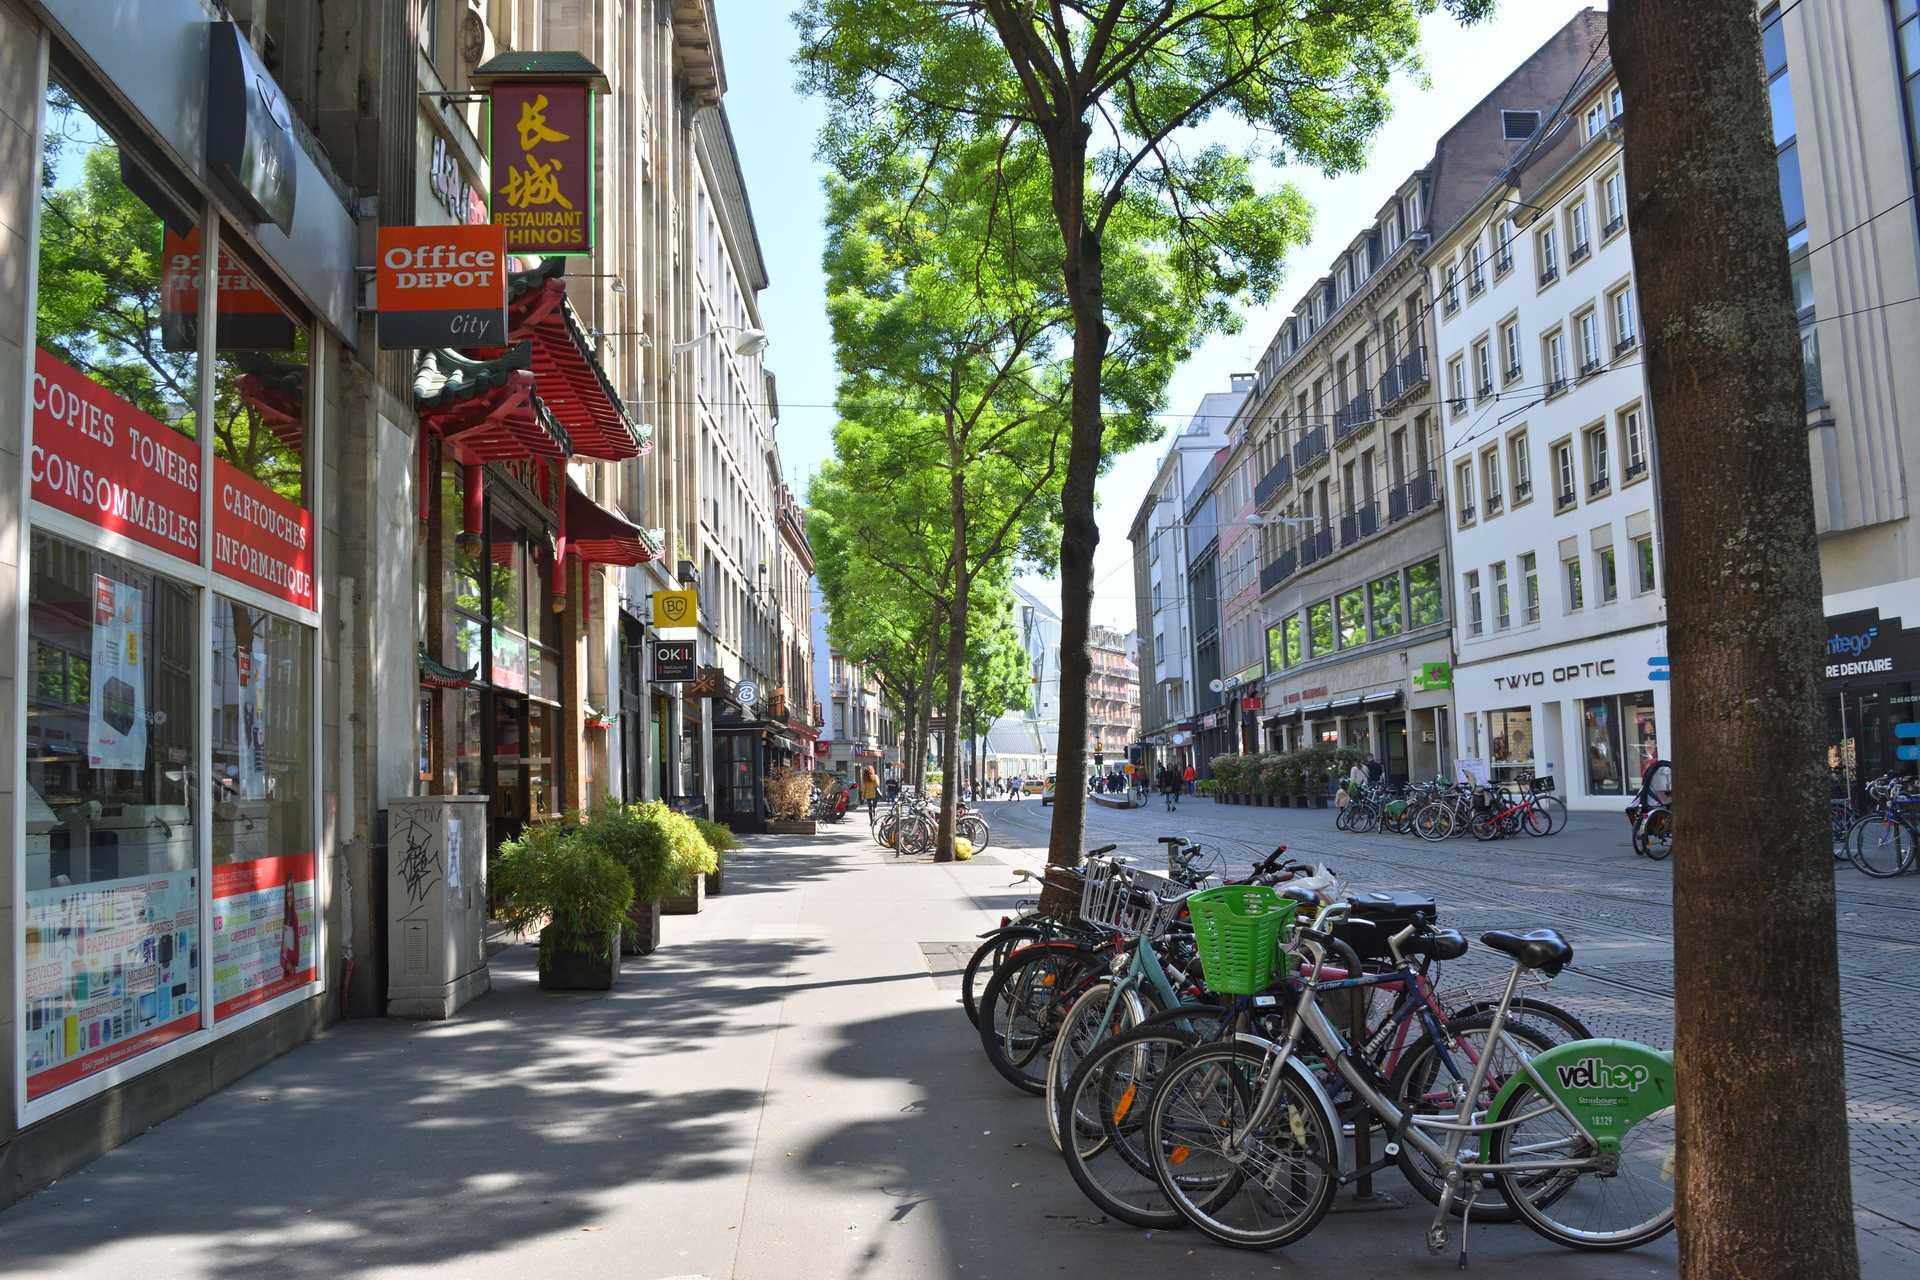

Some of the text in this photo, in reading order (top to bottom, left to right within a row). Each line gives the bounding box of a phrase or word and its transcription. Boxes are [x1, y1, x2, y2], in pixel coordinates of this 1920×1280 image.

[499, 93, 573, 210] 长城
[494, 211, 583, 227] RESTAURANT
[508, 228, 583, 245] HINOIS
[384, 244, 496, 270] Office
[395, 270, 494, 289] DEPOT
[450, 314, 491, 340] City
[32, 373, 199, 493] COPIES TONERS
[31, 445, 198, 550] CONSOMMABLES
[223, 484, 307, 551] CARTOUCHES
[215, 532, 311, 598] INFORMATIQUE
[666, 600, 684, 612] BC
[1494, 659, 1616, 691] TWYO OPTIC
[1825, 657, 1893, 678] RE DENTAIRE
[1557, 1058, 1648, 1091] vélhop
